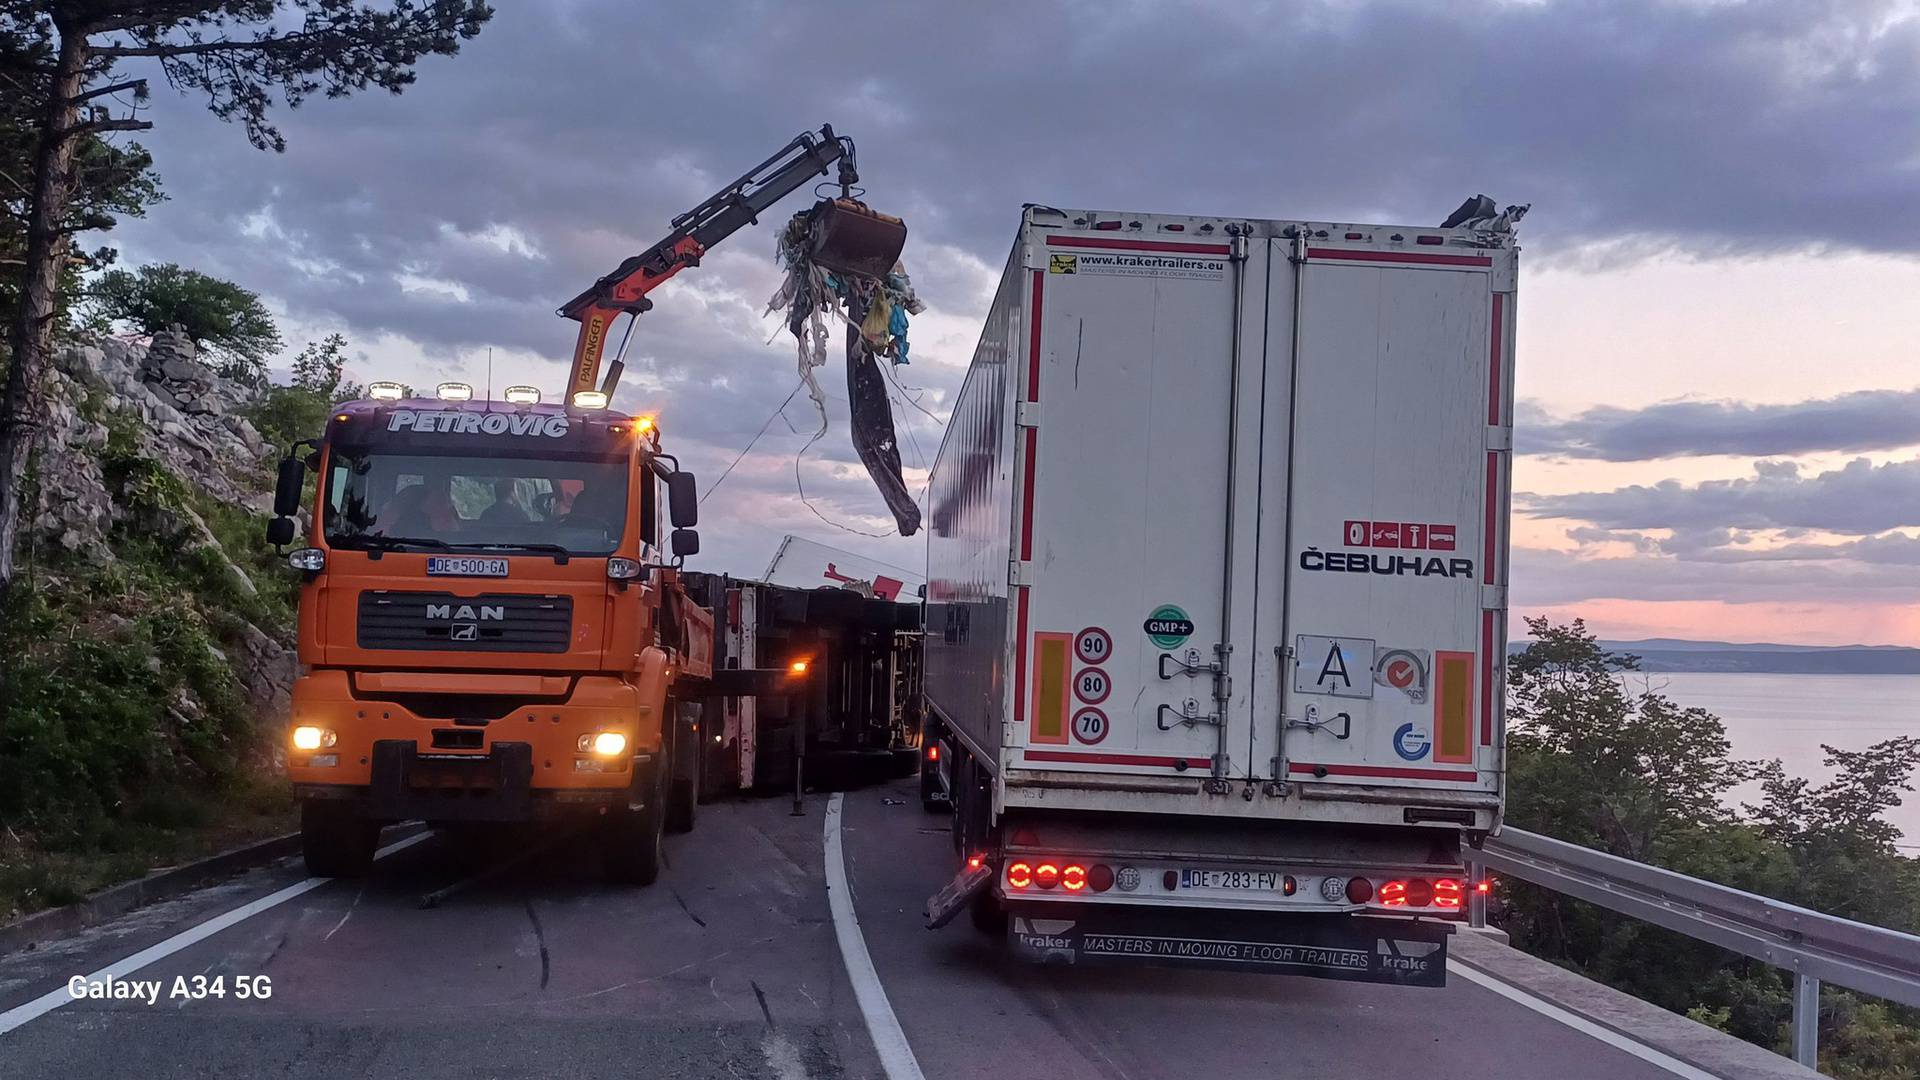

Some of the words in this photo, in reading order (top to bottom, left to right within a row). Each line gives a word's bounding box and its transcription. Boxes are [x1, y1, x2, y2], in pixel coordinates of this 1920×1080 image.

[1080, 255, 1223, 271] www.krakertrailers.eu
[580, 319, 603, 383] PALFINGER
[436, 559, 451, 572] DE
[460, 559, 505, 574] 500-GA
[1299, 546, 1474, 579] ČEBUHAR
[426, 604, 505, 620] MAN
[1149, 621, 1188, 633] GMP+
[1083, 638, 1103, 654] 90
[1316, 643, 1352, 688] A
[1083, 677, 1103, 693] 80
[1082, 717, 1101, 733] 70
[1191, 870, 1210, 888] DE
[1019, 933, 1072, 948] kraker
[1083, 937, 1153, 953] MASTERS
[1157, 941, 1173, 954] IN
[1177, 942, 1238, 957] MOVING
[1242, 946, 1293, 961] FLOOR
[1298, 949, 1369, 968] TRAILERS
[1382, 955, 1429, 970] krake
